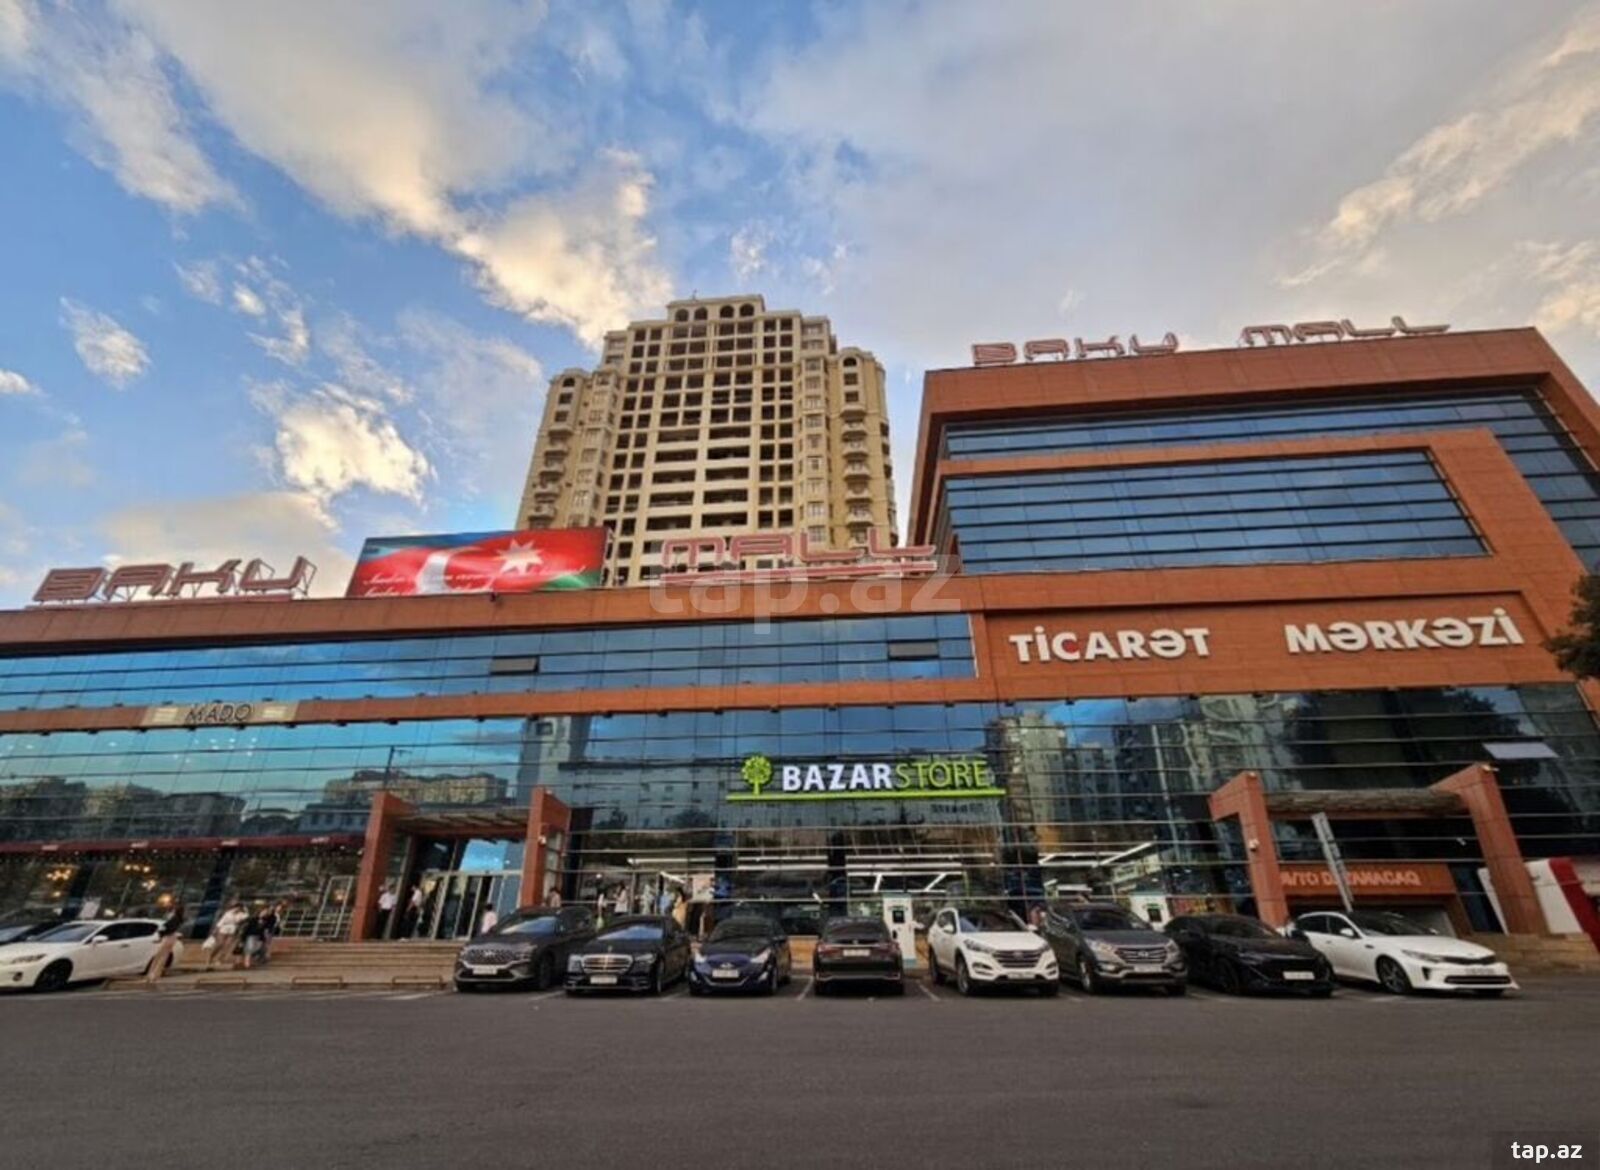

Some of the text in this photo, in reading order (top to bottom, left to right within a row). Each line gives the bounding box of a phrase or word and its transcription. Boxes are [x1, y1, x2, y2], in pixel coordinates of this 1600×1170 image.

[972, 315, 1451, 366] BAKU MALL
[32, 527, 938, 602] BAKU MALL
[1009, 607, 1525, 662] TİCARƏT MƏRKƏZİ
[184, 703, 252, 724] MADO
